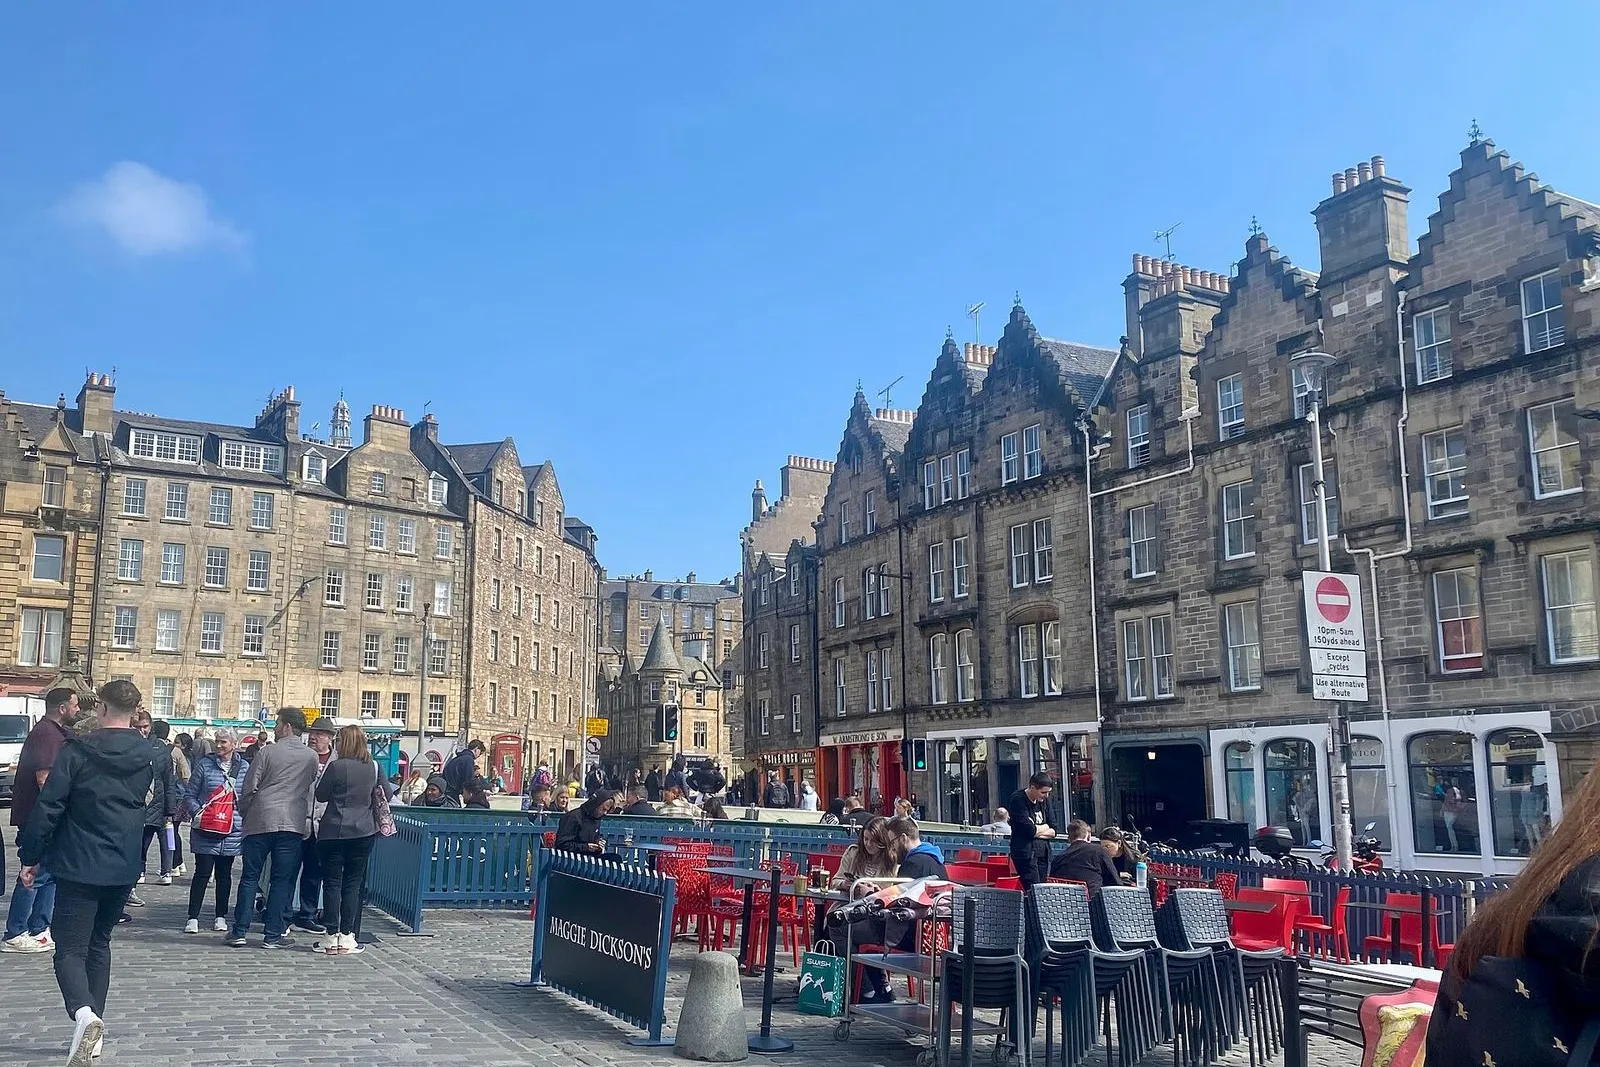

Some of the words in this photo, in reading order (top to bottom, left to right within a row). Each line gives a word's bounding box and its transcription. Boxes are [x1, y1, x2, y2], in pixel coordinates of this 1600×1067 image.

[1314, 636, 1338, 645] 150yds
[1340, 638, 1360, 646] ahead
[1327, 653, 1350, 662] Except
[1316, 678, 1329, 686] Use
[1330, 679, 1364, 688] alternative
[1331, 689, 1351, 697] Route
[877, 731, 888, 740] SON
[550, 916, 587, 948] MAGGIE
[590, 929, 652, 970] DICKSON'S
[806, 957, 831, 967] SWISH
